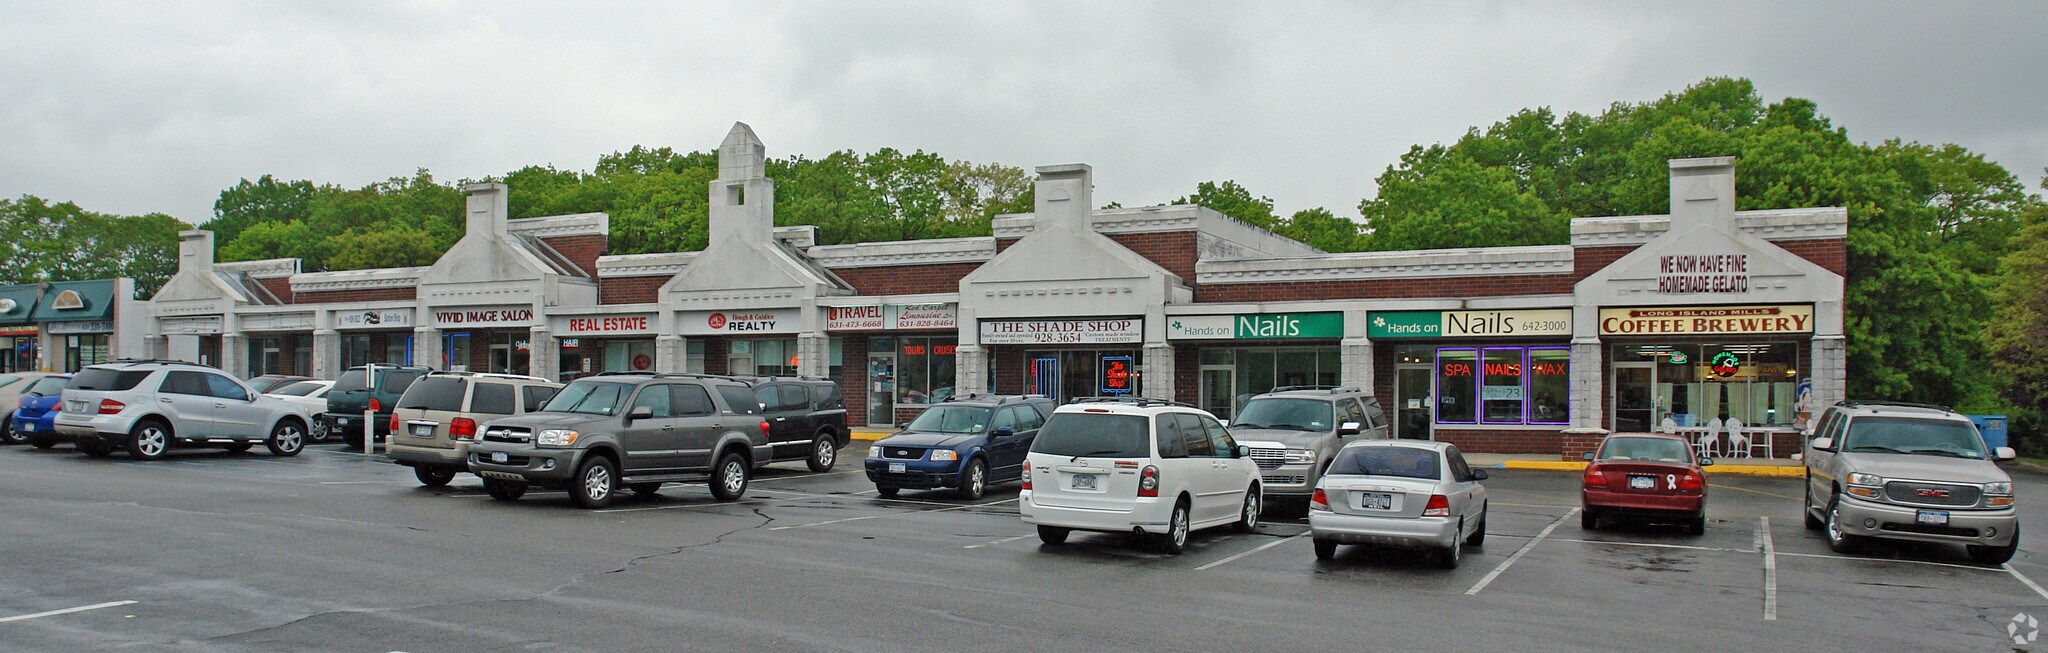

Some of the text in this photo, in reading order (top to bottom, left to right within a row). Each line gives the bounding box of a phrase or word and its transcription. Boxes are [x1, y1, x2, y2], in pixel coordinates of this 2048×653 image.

[1660, 254, 1747, 273] WE NOW HAVE FINE
[1659, 275, 1748, 293] HOMEMADE GELATO
[922, 304, 949, 312] Carpet
[1679, 309, 1727, 317] ISLAND
[436, 308, 533, 323] VIVID IMAGE SALON
[899, 311, 941, 320] Limousine
[569, 316, 647, 332] REAL ESTATE
[728, 321, 776, 331] REALTY
[990, 320, 1131, 333] THE SHADE SHOP
[1184, 315, 1300, 337] Hands on Nails
[1387, 312, 1567, 334] Hands on Nails 642-3000
[1602, 314, 1809, 334] COFFEE BREWERY
[563, 339, 579, 347] HAIR
[904, 345, 925, 355] TOURS
[1111, 361, 1124, 370] The
[1444, 363, 1472, 377] SPA
[1485, 363, 1522, 377] NAILS
[1534, 362, 1566, 376] WAX
[1108, 378, 1125, 388] Shop
[1916, 489, 1950, 498] GMC
